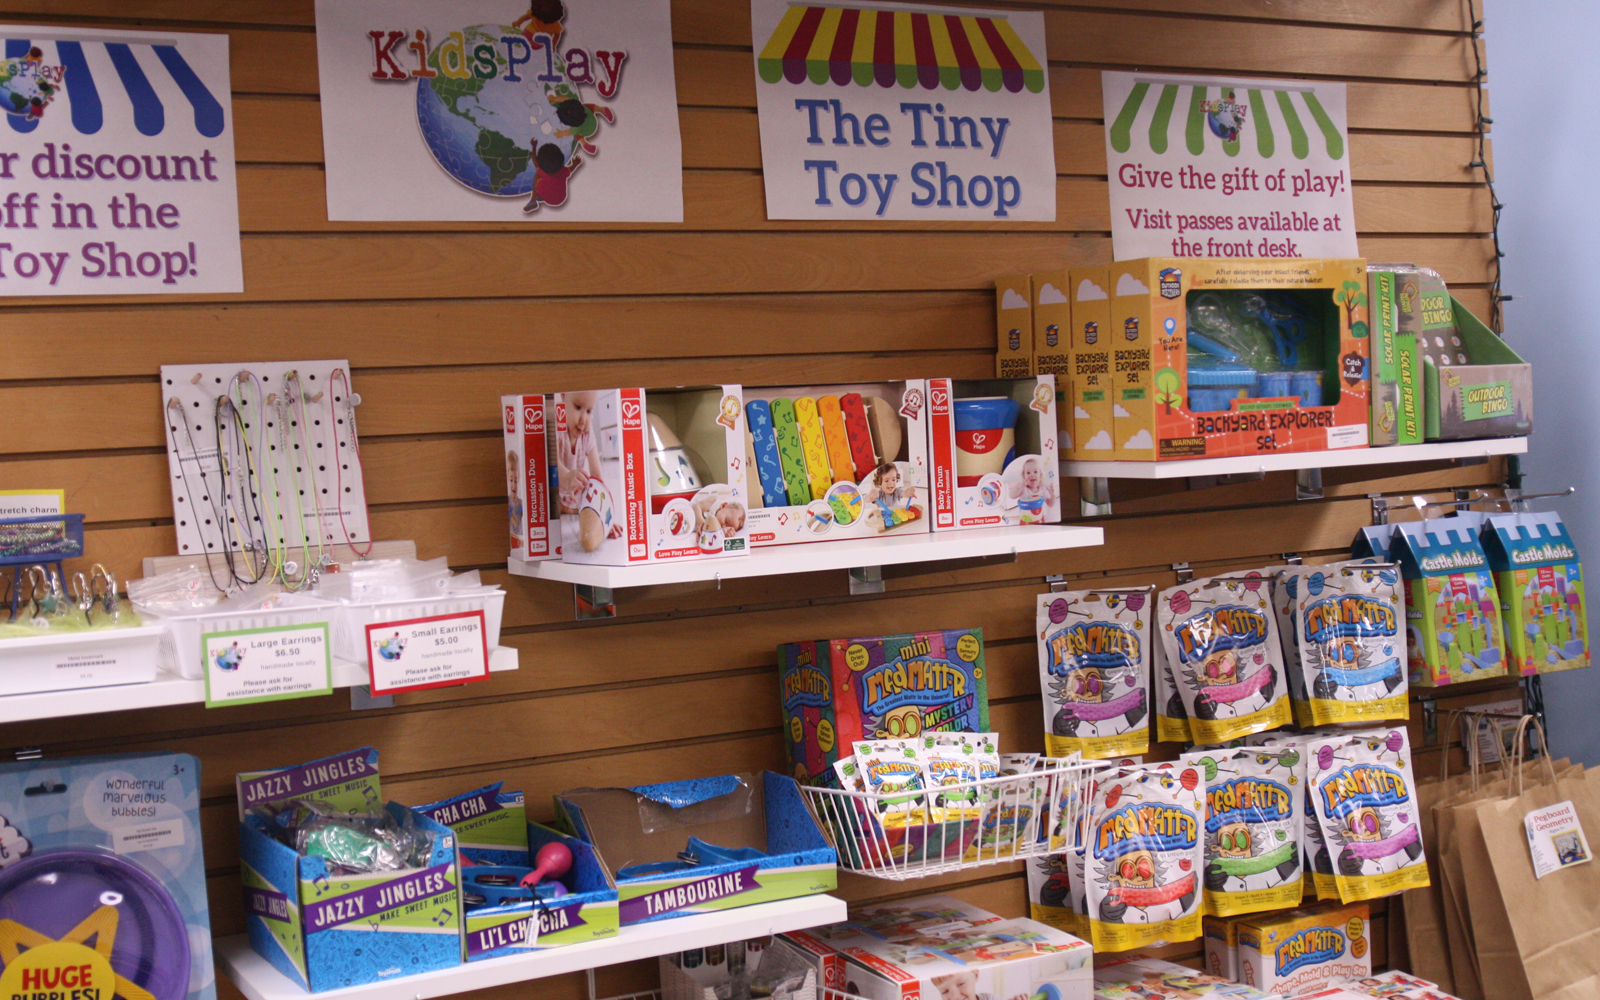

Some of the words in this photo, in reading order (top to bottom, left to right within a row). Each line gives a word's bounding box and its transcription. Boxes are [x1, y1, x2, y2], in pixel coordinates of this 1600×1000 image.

[0, 60, 66, 83] dsPlay
[368, 29, 627, 98] KidsPlay
[795, 98, 891, 147] The
[900, 102, 1011, 159] Tiny
[31, 142, 219, 182] discount
[804, 160, 898, 216] Toy
[911, 161, 1021, 217] Shop
[1118, 163, 1173, 189] Give
[1179, 165, 1217, 190] the
[1222, 167, 1260, 196] gift
[1264, 168, 1286, 192] of
[1291, 169, 1346, 197] play!
[0, 192, 39, 229] ff
[51, 192, 97, 229] in
[107, 193, 180, 229] the
[1125, 208, 1173, 230] Visit
[1177, 213, 1234, 234] passes
[1238, 211, 1320, 232] available
[1323, 213, 1342, 232] at
[1172, 237, 1203, 257] the
[1207, 237, 1254, 258] front
[1258, 238, 1303, 258] desk.
[81, 241, 198, 285] Shop!
[1379, 275, 1390, 292] KIT
[1381, 294, 1391, 328] PRINT
[1421, 296, 1446, 312] DOOR
[1422, 308, 1453, 325] BINGO
[1383, 331, 1394, 365] SOLAR
[1345, 358, 1362, 366] Catch
[1400, 350, 1412, 385] SOLAR
[1402, 386, 1416, 420] PRINT
[1467, 385, 1506, 404] OUTDOOR
[1482, 398, 1509, 415] BINGO
[525, 423, 543, 431] Hape
[623, 418, 641, 427] Hape
[1405, 420, 1418, 438] KIT
[1171, 437, 1206, 447] WARNING:
[528, 458, 536, 476] Duo
[626, 452, 634, 471] Box
[627, 472, 636, 500] Music
[529, 478, 538, 524] Percussion
[937, 486, 946, 511] Baby
[0, 506, 28, 514] tretch
[30, 506, 58, 514] charm
[629, 501, 638, 541] Rotating
[683, 548, 699, 557] Learn
[1422, 552, 1453, 571] Castle
[1454, 549, 1484, 567] Molds
[1512, 546, 1543, 563] Castle
[1543, 543, 1574, 560] Molds
[411, 628, 437, 639] Small
[439, 623, 479, 635] Earrings
[250, 640, 279, 649] Large
[281, 635, 323, 647] Earrings
[434, 636, 459, 646] $5.00
[900, 635, 932, 660] mini
[960, 637, 976, 645] Perfect
[275, 647, 300, 658] $6.50
[421, 650, 453, 659] handmade
[453, 647, 474, 656] locally
[797, 647, 812, 667] mini
[848, 648, 863, 657] Never
[850, 654, 865, 662] Dries
[959, 648, 977, 656] Sensory
[260, 661, 294, 671] handmade
[295, 659, 316, 667] locally
[405, 668, 428, 676] Please
[429, 665, 441, 673] ask
[852, 660, 865, 668] Out!
[243, 679, 267, 687] Please
[389, 676, 426, 686] assistance
[427, 673, 442, 681] with
[443, 669, 471, 679] earrings
[226, 688, 265, 697] assistance
[266, 685, 282, 693] with
[282, 682, 312, 692] earrings
[884, 697, 903, 707] Greatest
[930, 692, 951, 701] Universe!
[924, 693, 974, 729] MYSTERY
[106, 778, 165, 791] wonderful
[246, 774, 292, 802] JAZZY
[303, 756, 366, 788] JINGLES
[103, 791, 167, 804] marvelous
[318, 786, 341, 800] SWEET
[345, 780, 368, 793] MUSIC
[111, 806, 157, 818] bubbles!
[434, 806, 460, 826] CHA
[461, 795, 487, 818] CHA
[1533, 806, 1571, 824] Pegboard
[464, 819, 487, 832] SWEET
[488, 812, 510, 824] MUSIC
[1536, 815, 1574, 832] Geometry
[314, 896, 365, 927] JAZZY
[376, 872, 445, 909] JINGLES
[644, 871, 743, 914] TAMBOURINE
[379, 910, 400, 923] MAKE
[404, 900, 428, 916] SWEET
[433, 892, 457, 908] MUSIC
[479, 927, 507, 950] LI'L
[508, 920, 530, 942] CH
[22, 964, 92, 991] HUGE
[1299, 966, 1321, 983] Mold
[1322, 965, 1331, 978] &
[1331, 963, 1352, 979] Play
[1352, 963, 1368, 977] Set
